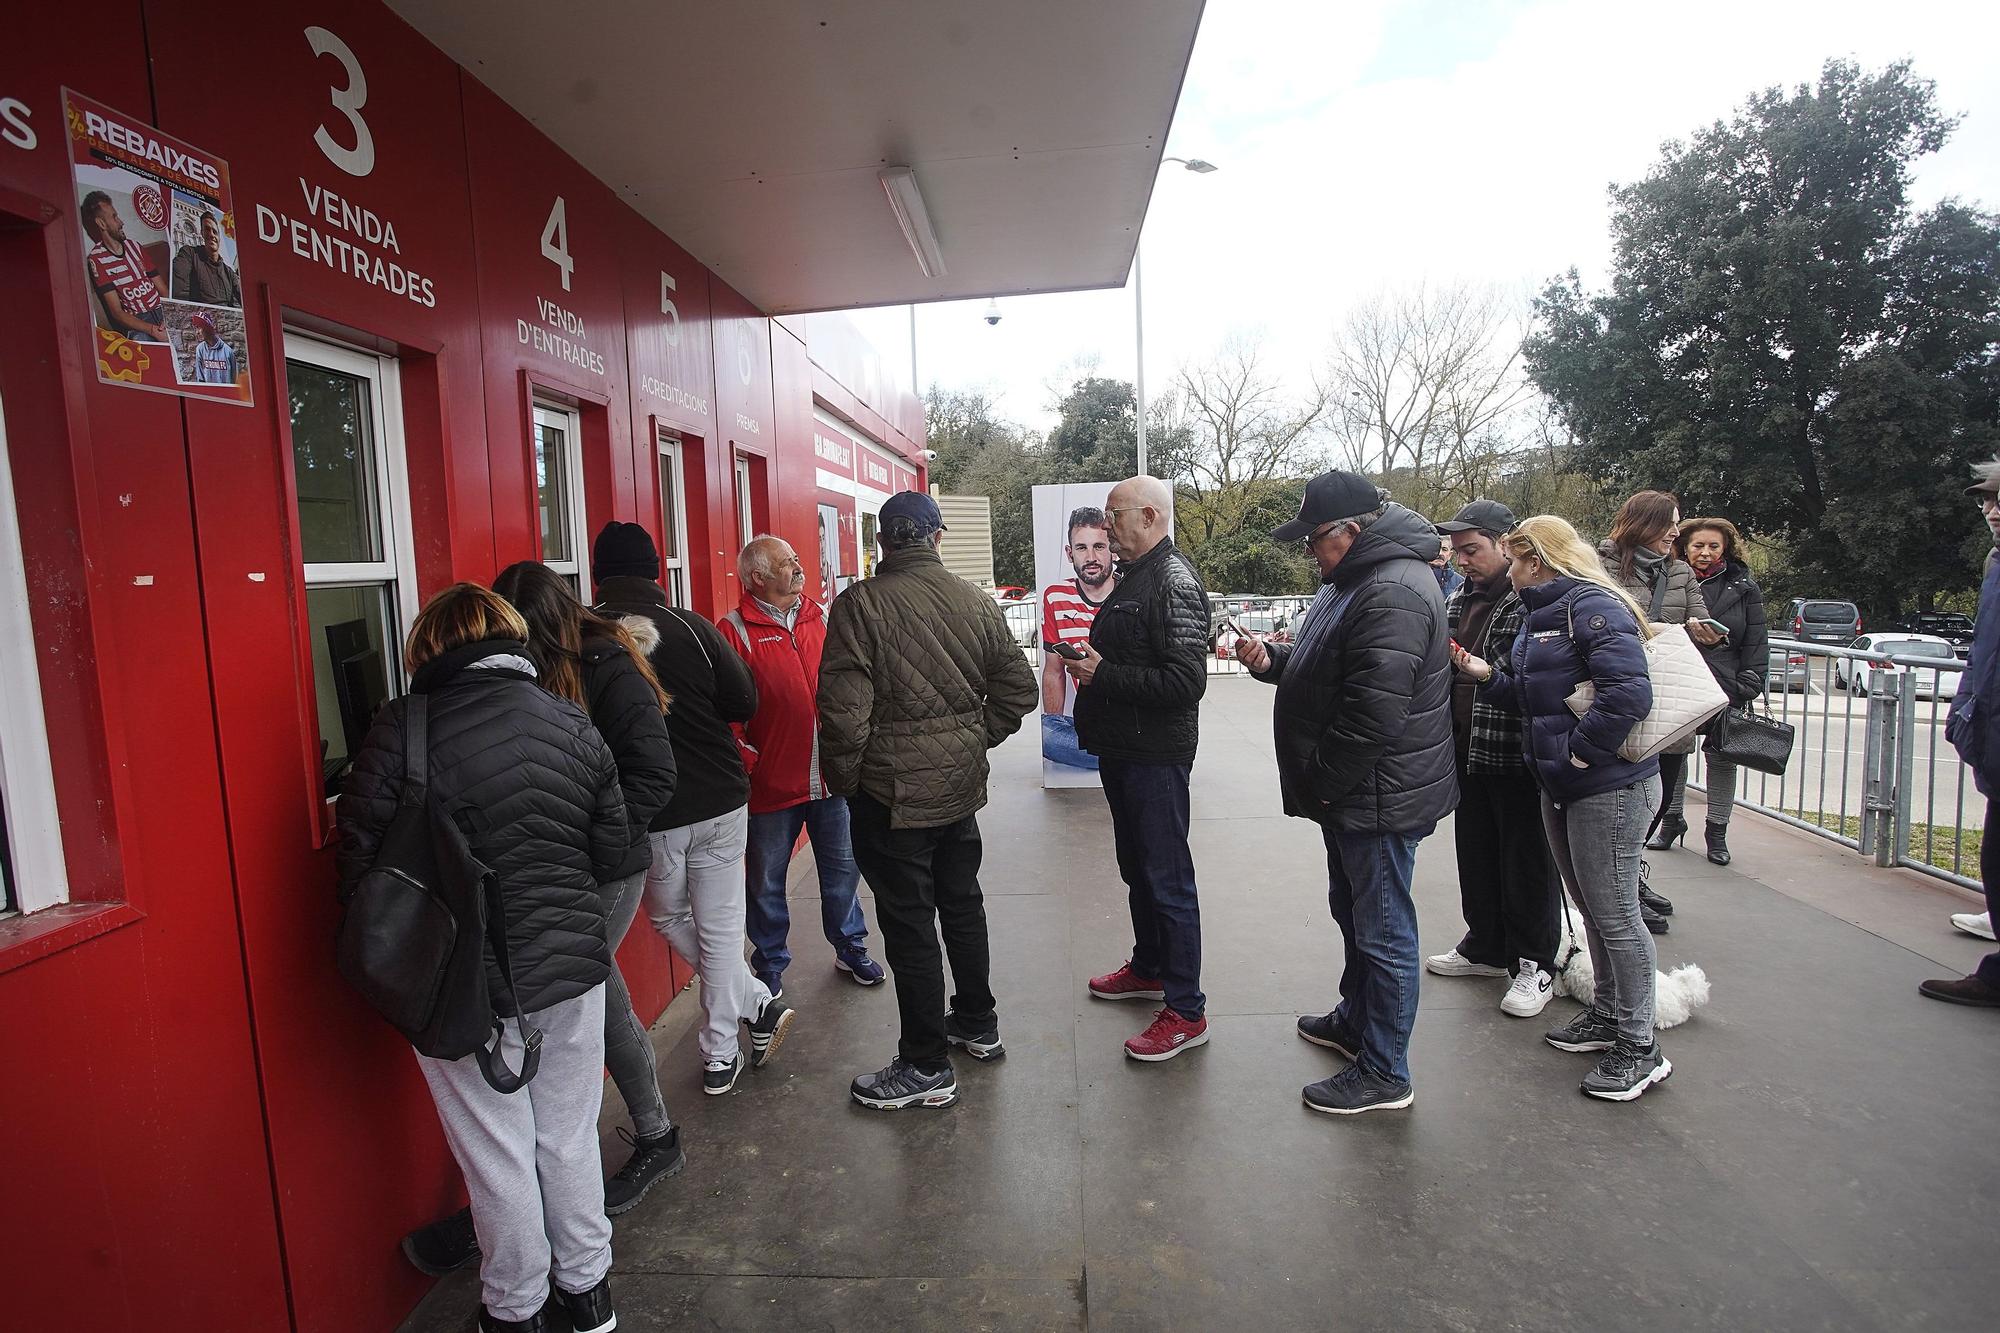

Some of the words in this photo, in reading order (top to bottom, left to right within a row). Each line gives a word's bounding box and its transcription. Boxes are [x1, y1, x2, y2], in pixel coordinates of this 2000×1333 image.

[304, 26, 375, 177] 3
[85, 110, 220, 189] REBAIXES
[89, 136, 113, 153] DEL
[130, 155, 146, 167] AL
[150, 162, 163, 173] 27
[167, 170, 181, 181] DE
[186, 179, 220, 198] GENER
[165, 179, 179, 189] TOTA
[299, 177, 400, 254] VENDA
[540, 196, 574, 293] 4
[256, 203, 436, 309] D'ENTRADES
[537, 296, 586, 340] VENDA
[660, 270, 682, 348] 5
[517, 318, 605, 376] D'ENTRADES
[641, 374, 708, 416] ACREDITACIONS
[736, 413, 761, 435] PREMSA
